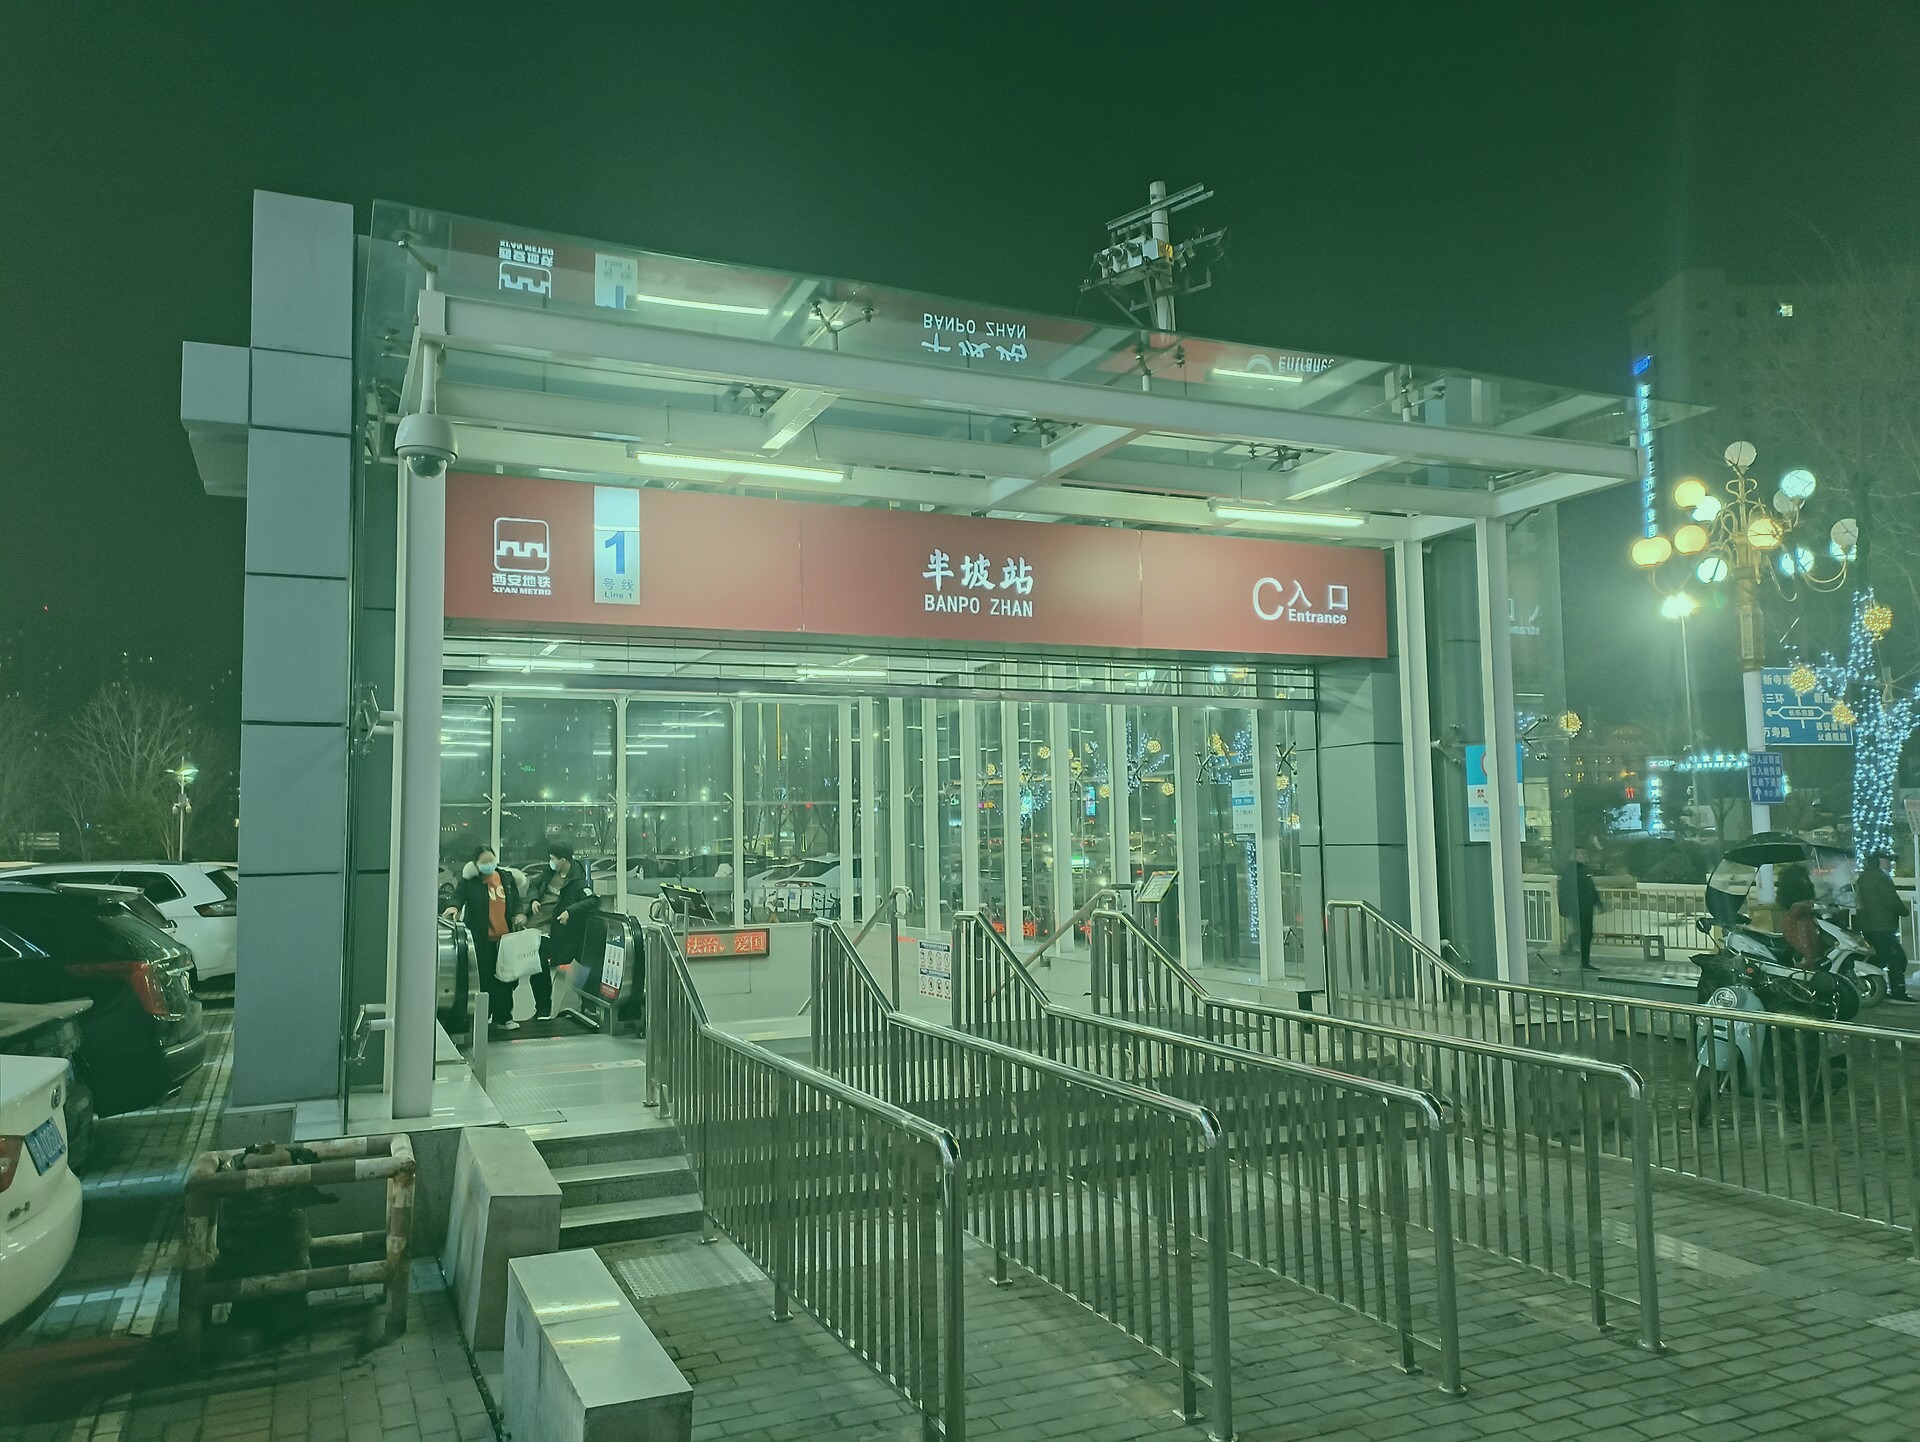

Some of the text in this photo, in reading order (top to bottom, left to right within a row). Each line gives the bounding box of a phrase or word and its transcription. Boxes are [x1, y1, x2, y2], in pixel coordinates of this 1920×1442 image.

[605, 531, 625, 574] 1
[492, 573, 551, 588] 西安地铁
[922, 548, 1034, 595] 半坡站
[520, 588, 551, 596] METRO
[603, 578, 634, 591] 号线
[605, 591, 624, 599] Line
[1253, 577, 1284, 621] C
[1287, 579, 1349, 611] 入口
[924, 594, 1033, 618] BANPO ZHAN
[1288, 609, 1347, 624] Entrance
